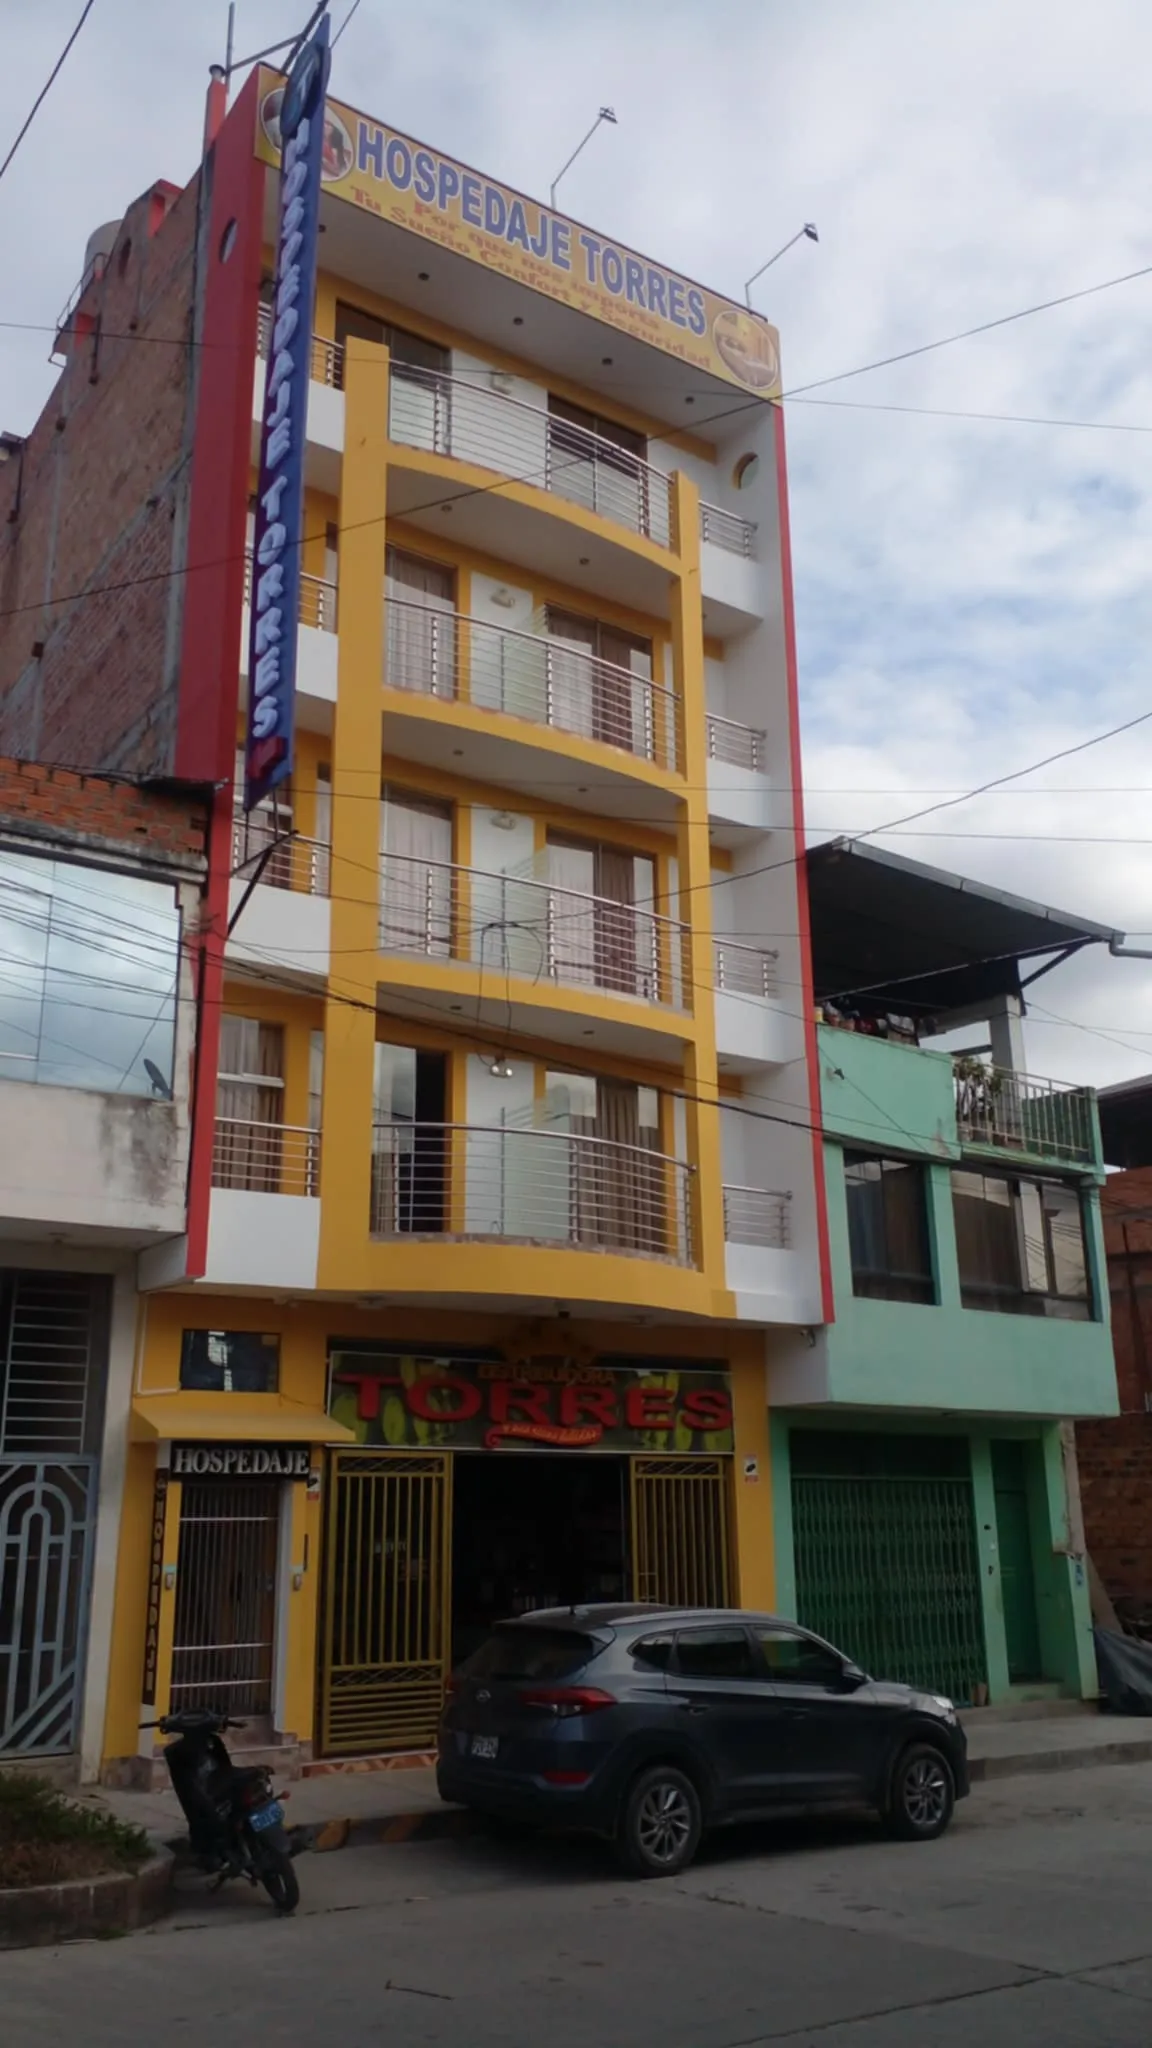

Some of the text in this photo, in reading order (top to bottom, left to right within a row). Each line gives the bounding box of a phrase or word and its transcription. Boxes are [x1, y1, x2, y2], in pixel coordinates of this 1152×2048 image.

[350, 185, 382, 214] Tu
[357, 120, 706, 337] HOSPEDAJE TORRES
[413, 201, 461, 231] Por
[468, 231, 513, 260] que
[252, 475, 288, 738] TORRES
[334, 1372, 734, 1431] TORRES
[174, 1448, 310, 1475] HOSPEDAJE
